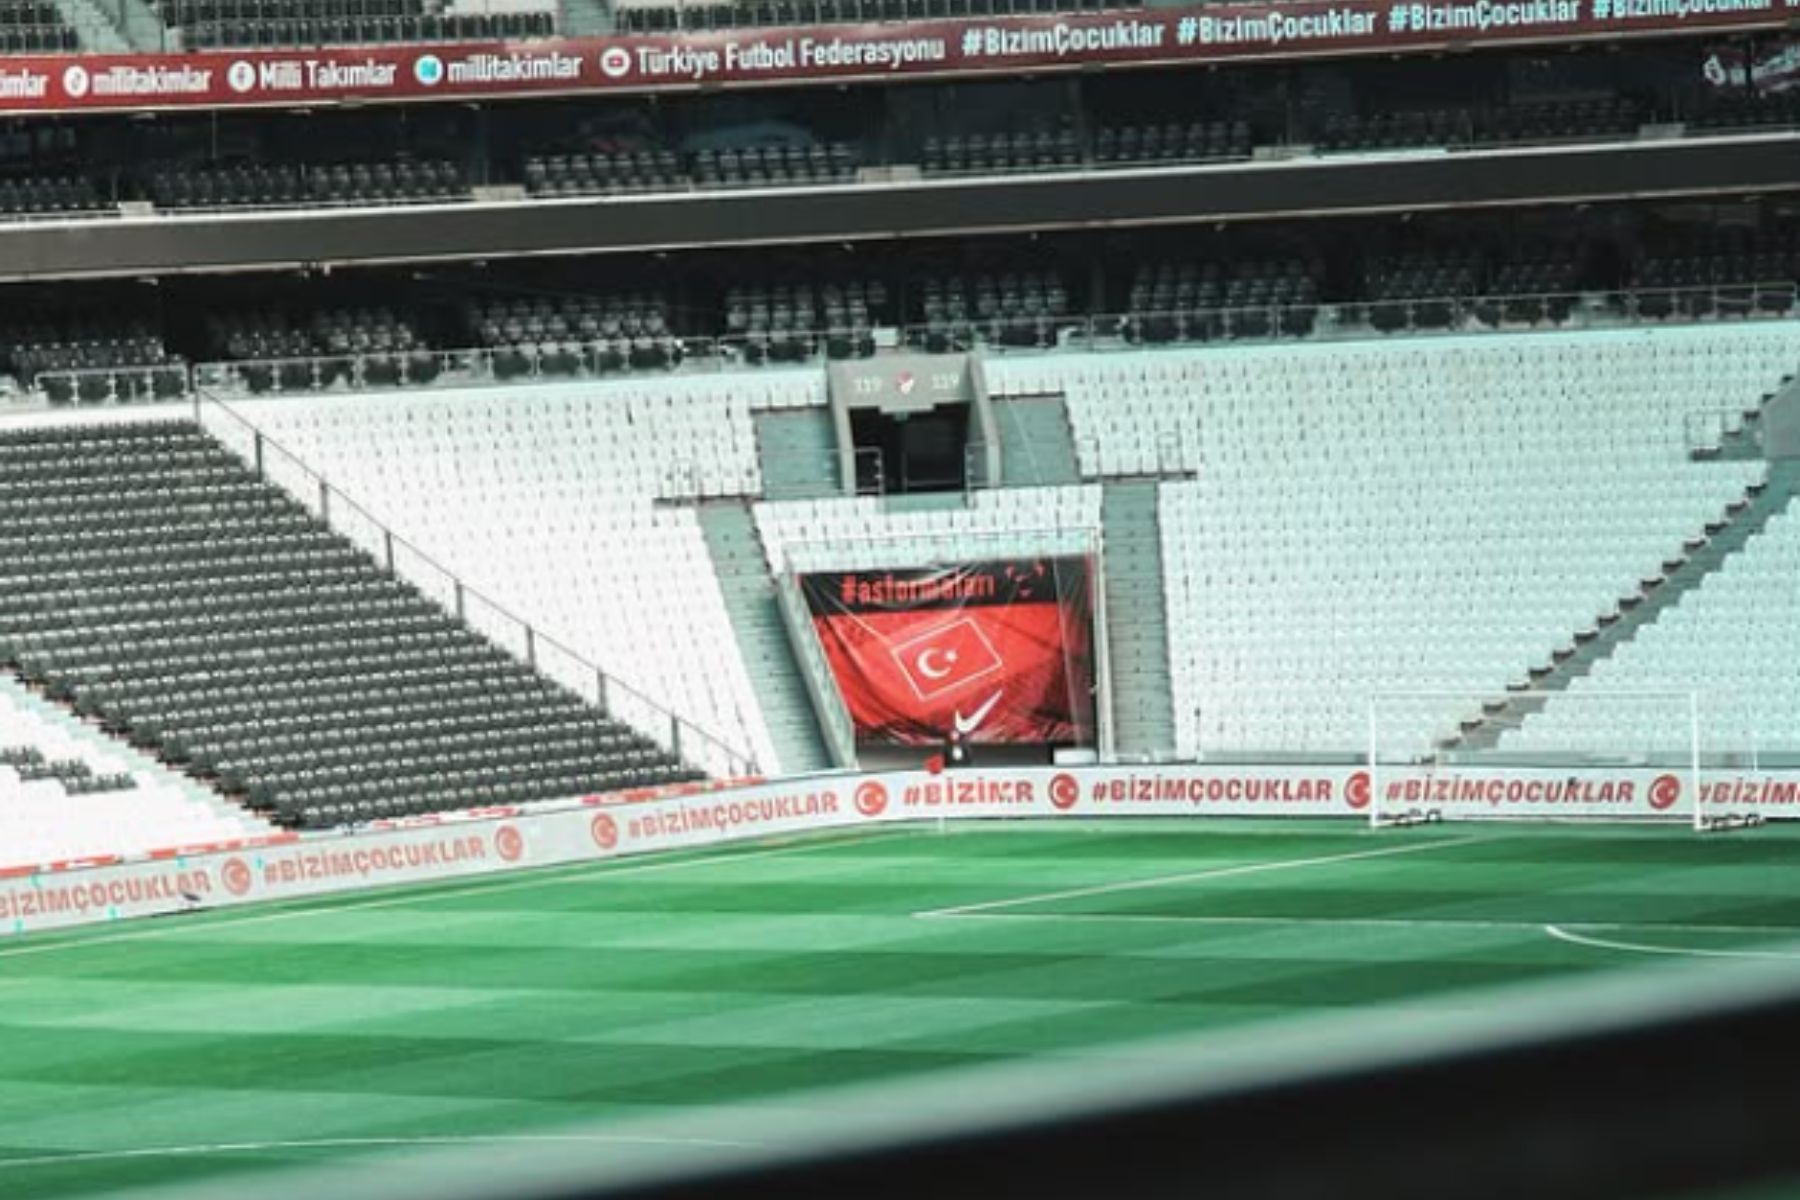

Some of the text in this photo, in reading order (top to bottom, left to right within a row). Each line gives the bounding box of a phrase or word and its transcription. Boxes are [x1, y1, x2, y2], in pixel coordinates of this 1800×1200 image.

[636, 38, 946, 78] Türkiye Futbol Federasyonu
[1092, 774, 1333, 806] #BİZİMÇOCUKLAR
[1386, 774, 1635, 806] #BİZİMÇOCUKLAR
